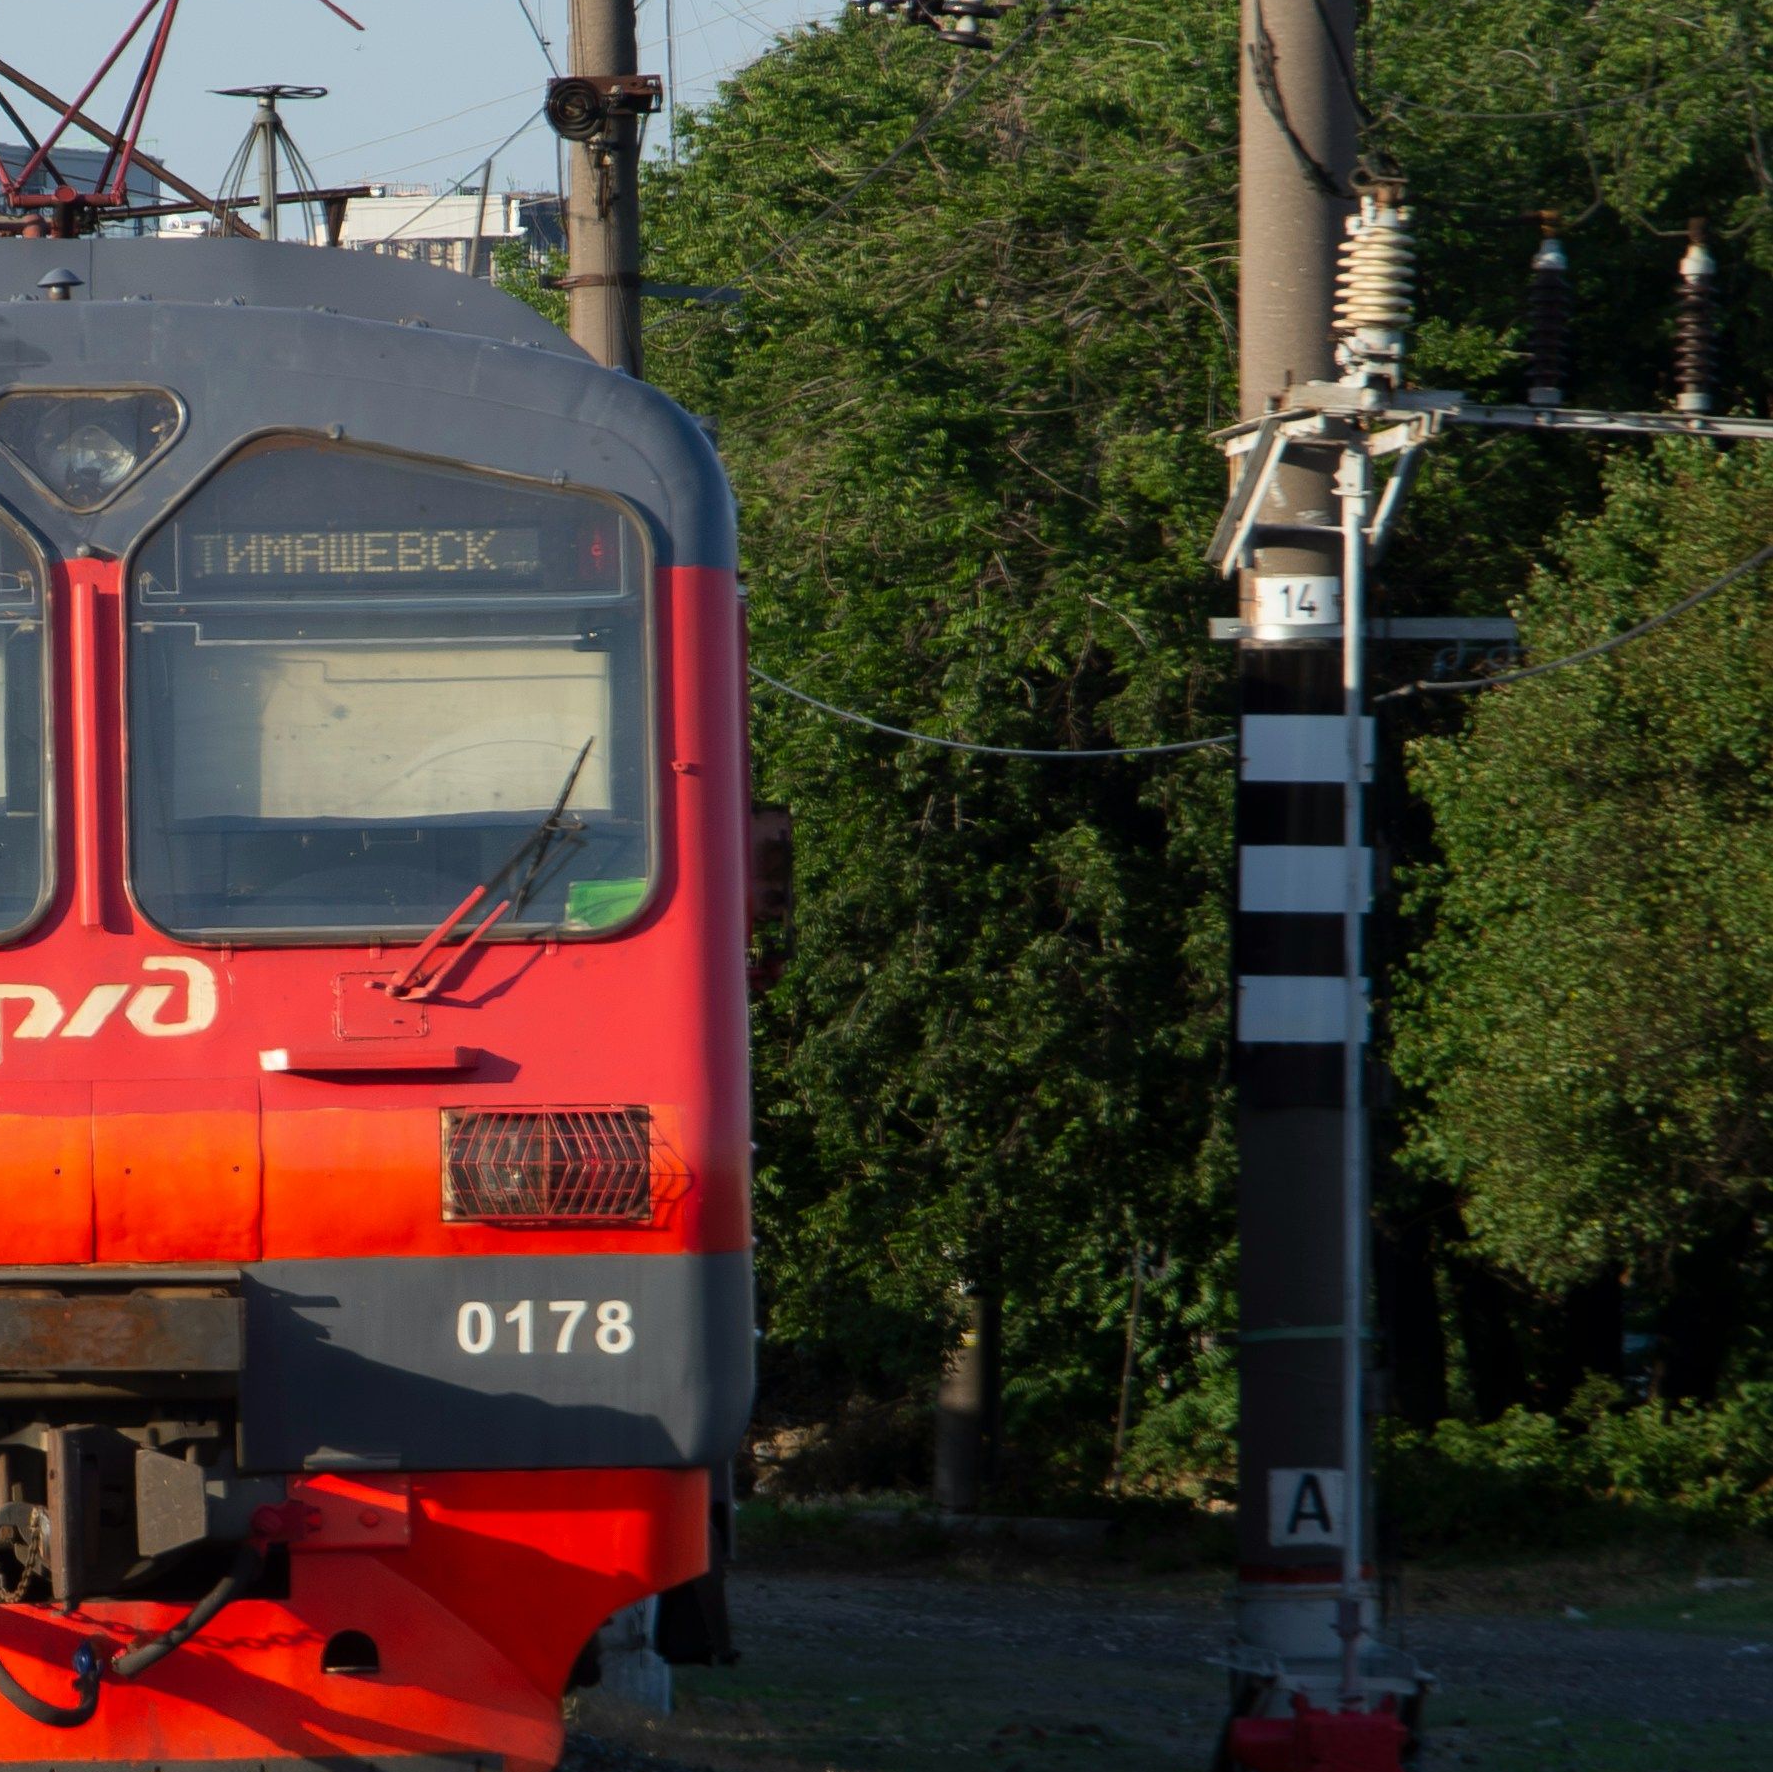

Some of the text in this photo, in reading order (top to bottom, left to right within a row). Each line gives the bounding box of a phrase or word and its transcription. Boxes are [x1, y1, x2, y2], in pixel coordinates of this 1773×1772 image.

[192, 530, 497, 574] ТИМАШЕВСК
[1279, 583, 1318, 618] 14
[456, 1299, 635, 1355] 0178
